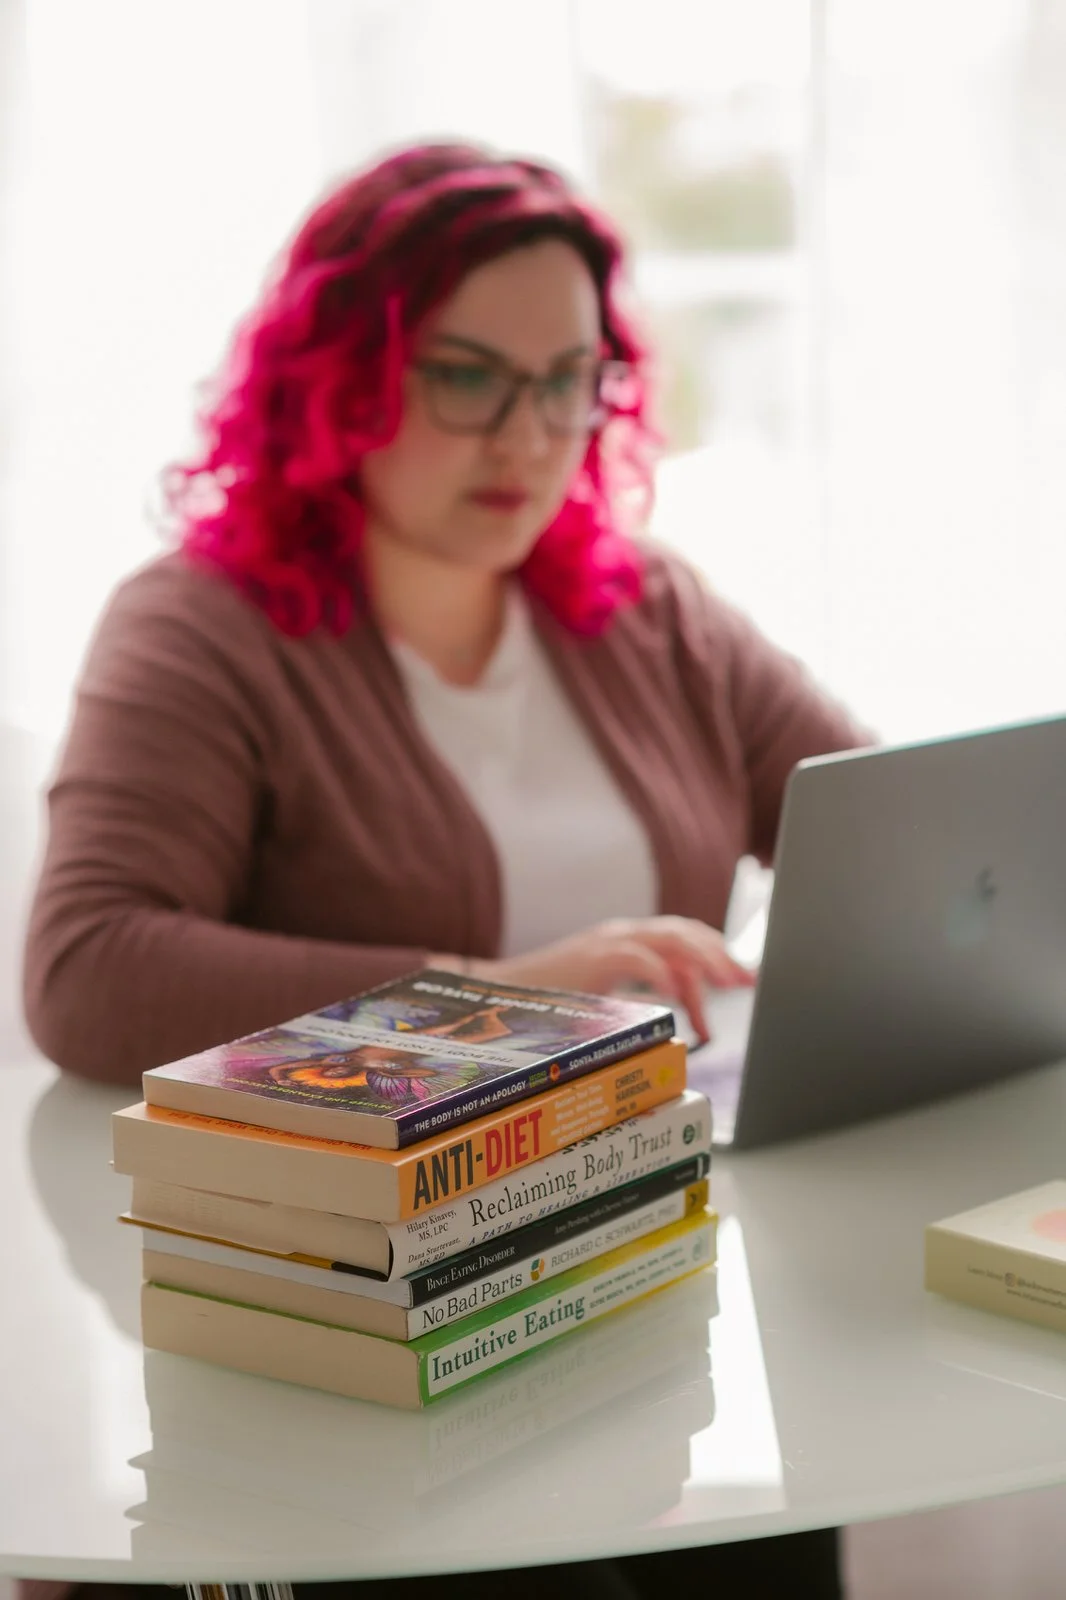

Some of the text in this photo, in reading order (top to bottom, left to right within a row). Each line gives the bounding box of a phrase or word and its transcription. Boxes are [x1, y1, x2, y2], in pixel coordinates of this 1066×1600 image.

[414, 1080, 527, 1133] THE BODY IS NOT AN APOLOGY
[413, 1108, 543, 1211] ANTI-DIET
[468, 1169, 577, 1227] Reclaiming
[583, 1144, 624, 1181] Body
[628, 1126, 672, 1160] Trust
[406, 1208, 457, 1235] Hilary Kinavey,
[418, 1222, 449, 1242] MS, LPC
[469, 1237, 476, 1247] A
[482, 1221, 513, 1241] PATH
[519, 1212, 533, 1225] TO
[538, 1189, 589, 1217] HEALING
[408, 1251, 425, 1264] Dana
[551, 1241, 593, 1268] RICHARD
[422, 1272, 523, 1329] No Bad Parts
[432, 1296, 585, 1382] Intuitive Eating
